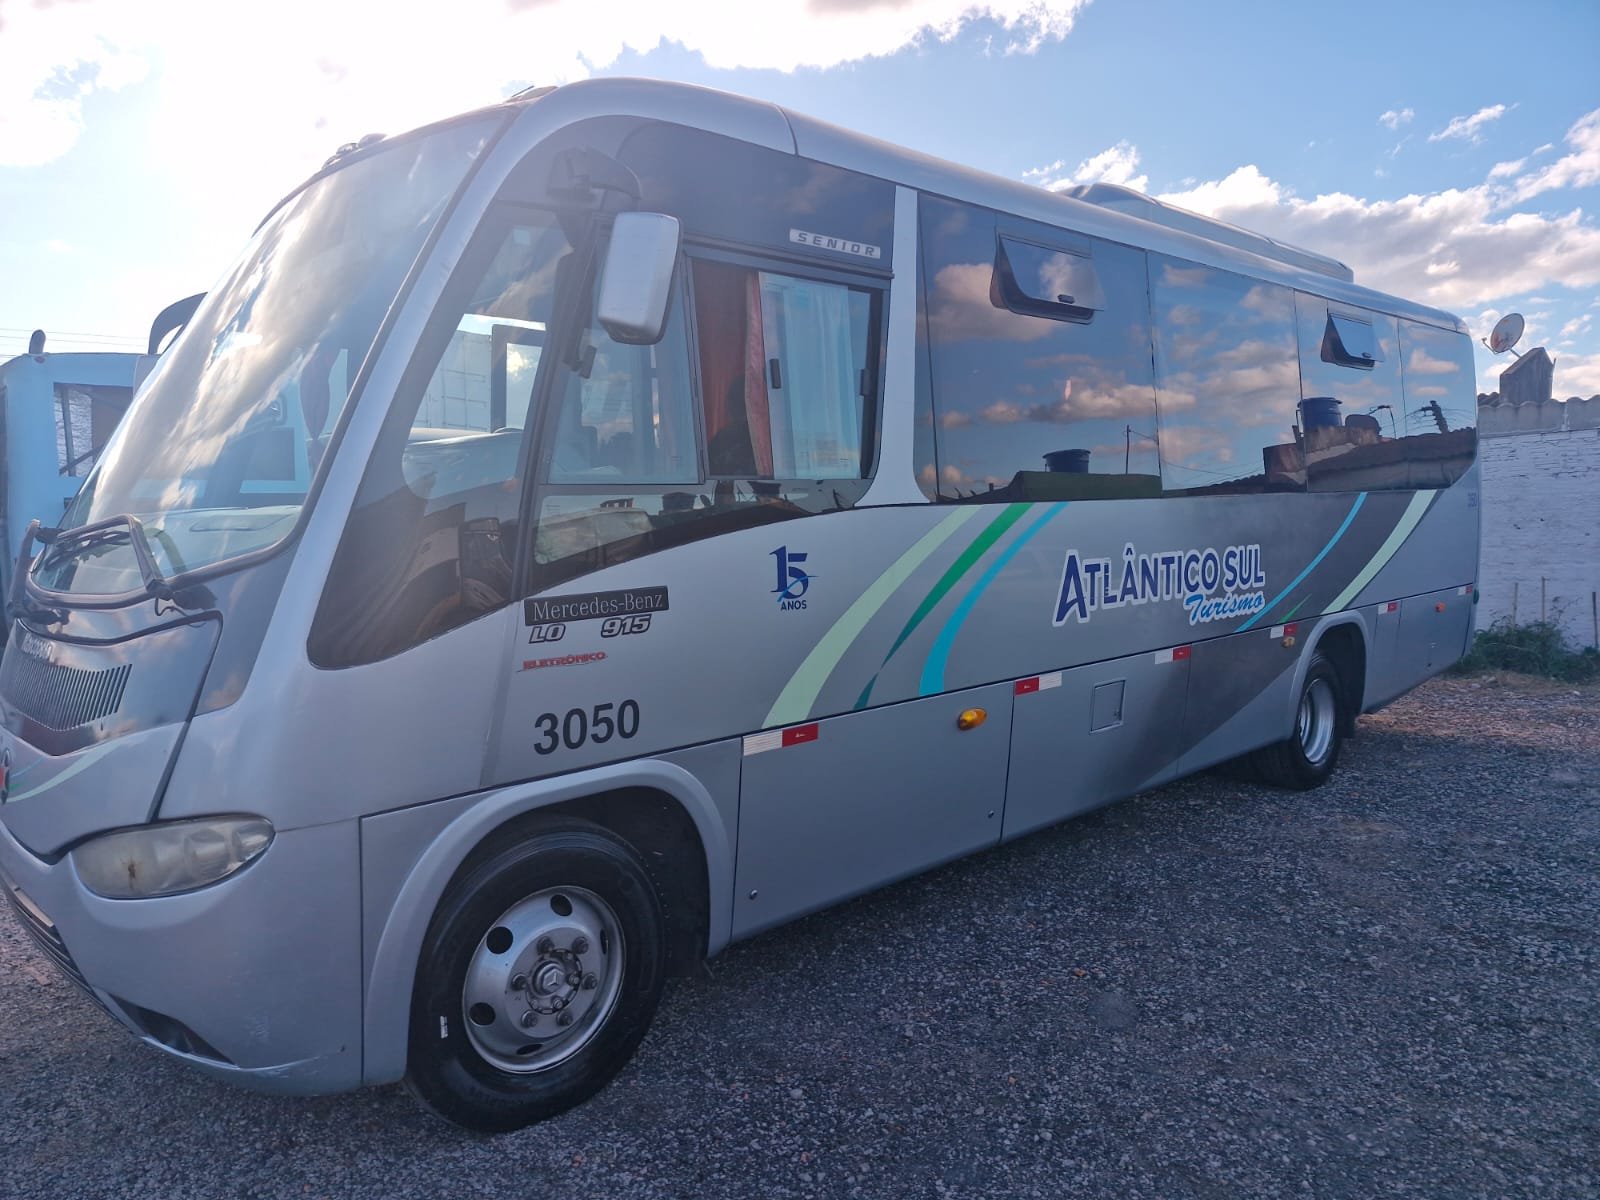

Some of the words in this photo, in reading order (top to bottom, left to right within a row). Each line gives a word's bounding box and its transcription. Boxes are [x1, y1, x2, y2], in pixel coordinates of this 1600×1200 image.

[797, 232, 875, 256] SENIOR
[769, 545, 809, 600] 15
[1054, 546, 1220, 623] ATLÂNTICO
[1225, 547, 1264, 588] SUL
[533, 593, 664, 621] Mercedes-Benz
[780, 600, 807, 611] ANOS
[1184, 594, 1263, 622] Turismo
[528, 623, 566, 644] LO
[600, 614, 652, 638] 915
[522, 651, 606, 671] ELETRÔNICO
[533, 699, 640, 756] 3050
